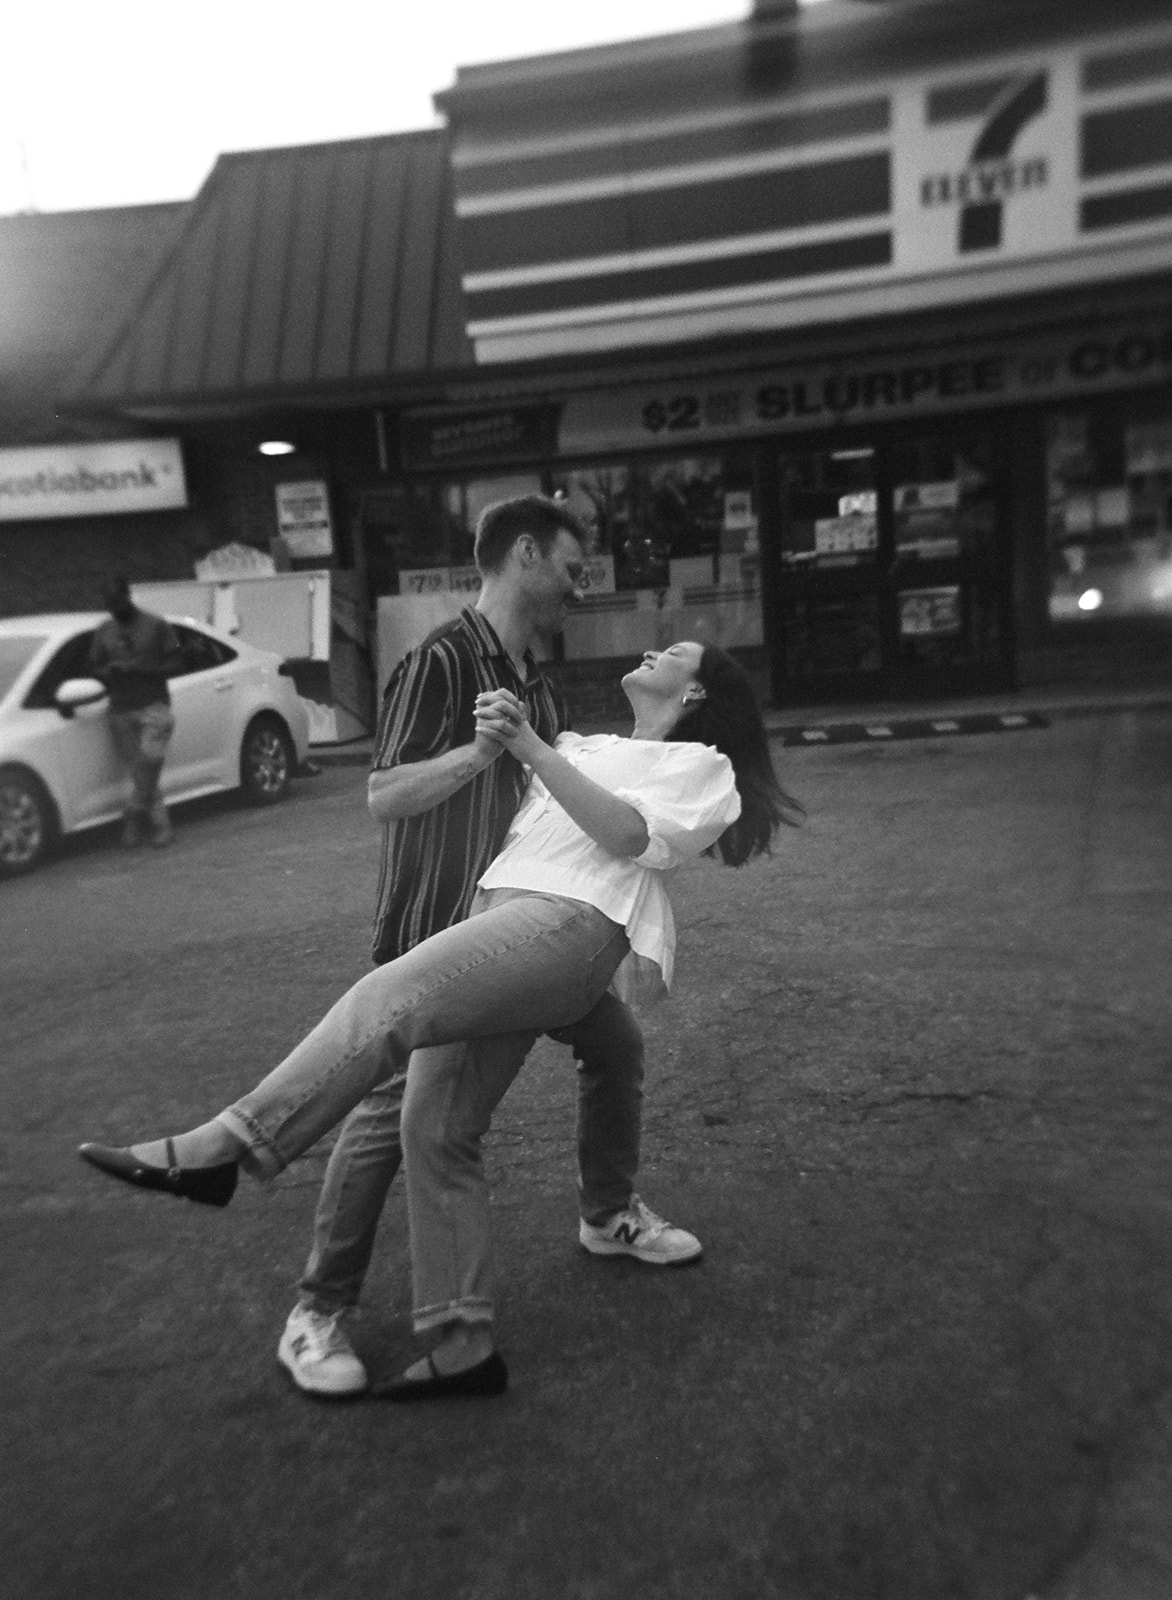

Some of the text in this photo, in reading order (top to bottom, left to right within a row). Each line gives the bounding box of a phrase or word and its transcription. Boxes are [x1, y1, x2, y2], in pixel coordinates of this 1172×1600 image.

[925, 68, 1049, 254] 7
[642, 396, 699, 432] $2
[756, 357, 1005, 420] SLURPEE
[613, 1222, 641, 1245] N
